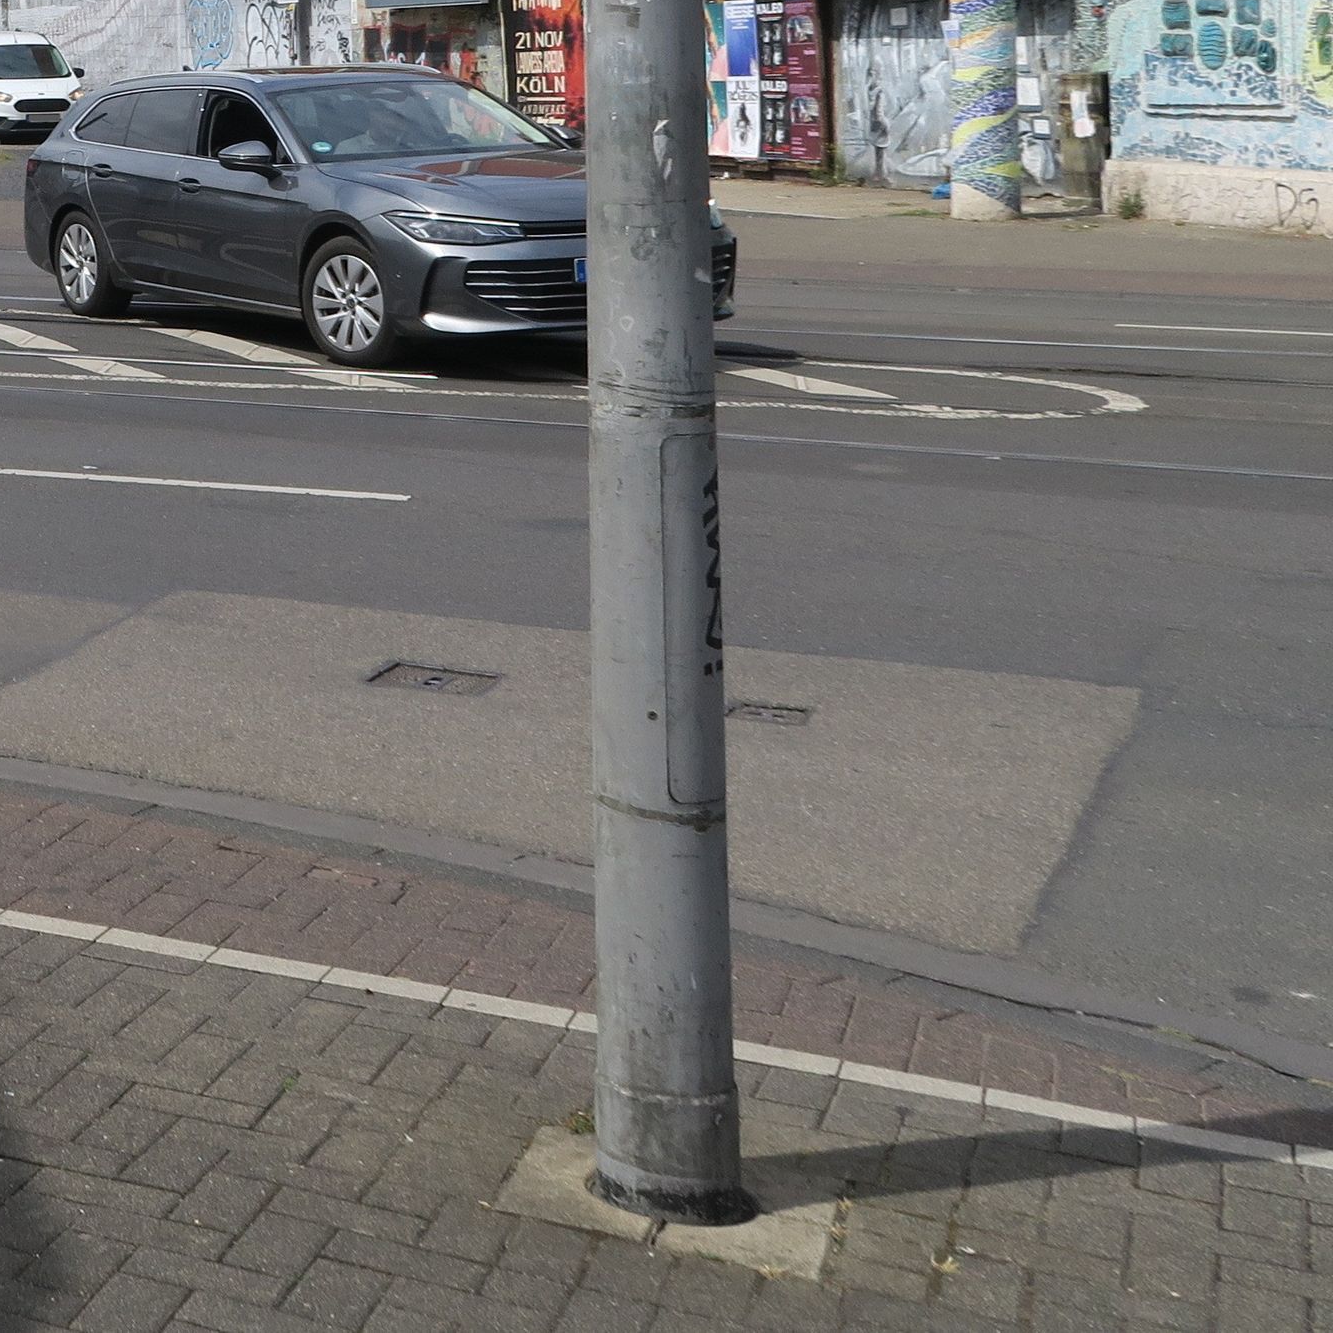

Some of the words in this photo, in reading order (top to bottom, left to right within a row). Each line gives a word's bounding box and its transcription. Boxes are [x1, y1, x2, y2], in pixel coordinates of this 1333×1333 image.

[515, 32, 531, 50] 21
[534, 30, 564, 49] NOV
[517, 75, 566, 94] KÖLN
